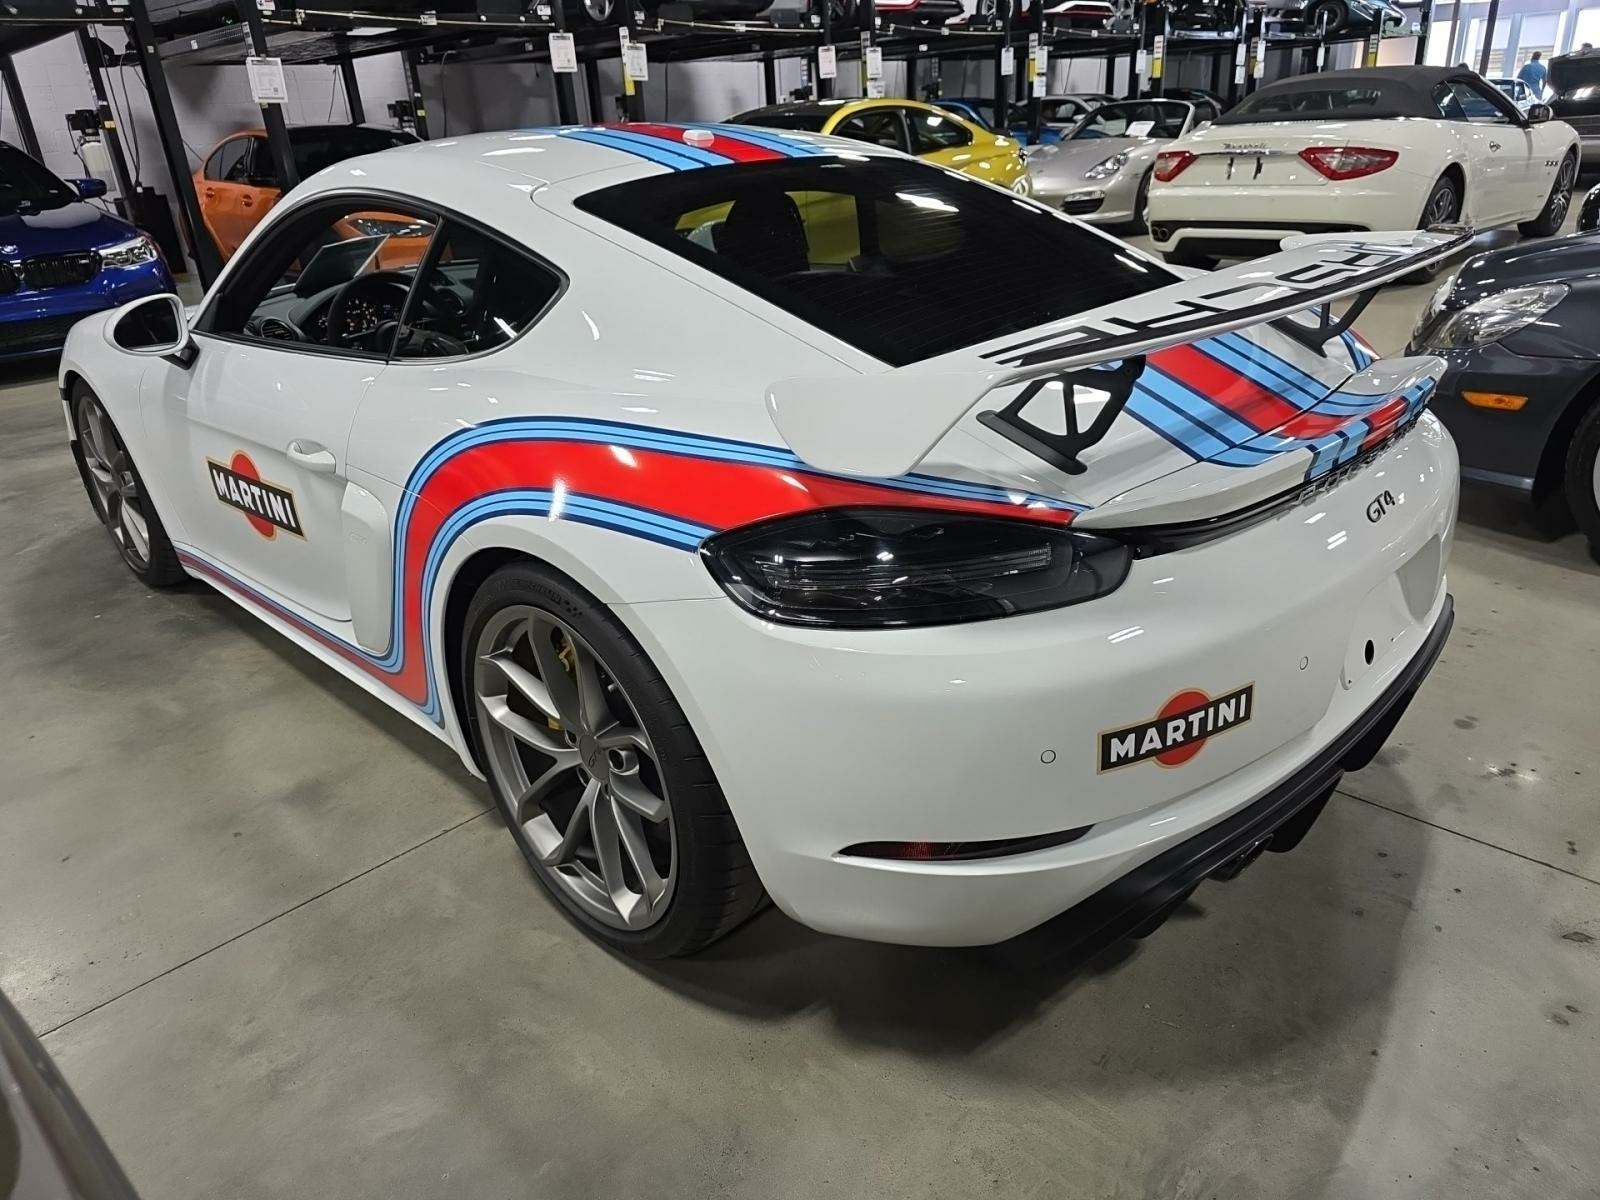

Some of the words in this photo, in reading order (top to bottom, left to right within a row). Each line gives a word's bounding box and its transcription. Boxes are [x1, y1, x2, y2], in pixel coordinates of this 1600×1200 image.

[211, 468, 297, 528] MARTINI
[1366, 489, 1396, 523] GT4
[1109, 693, 1247, 763] MARTINI
